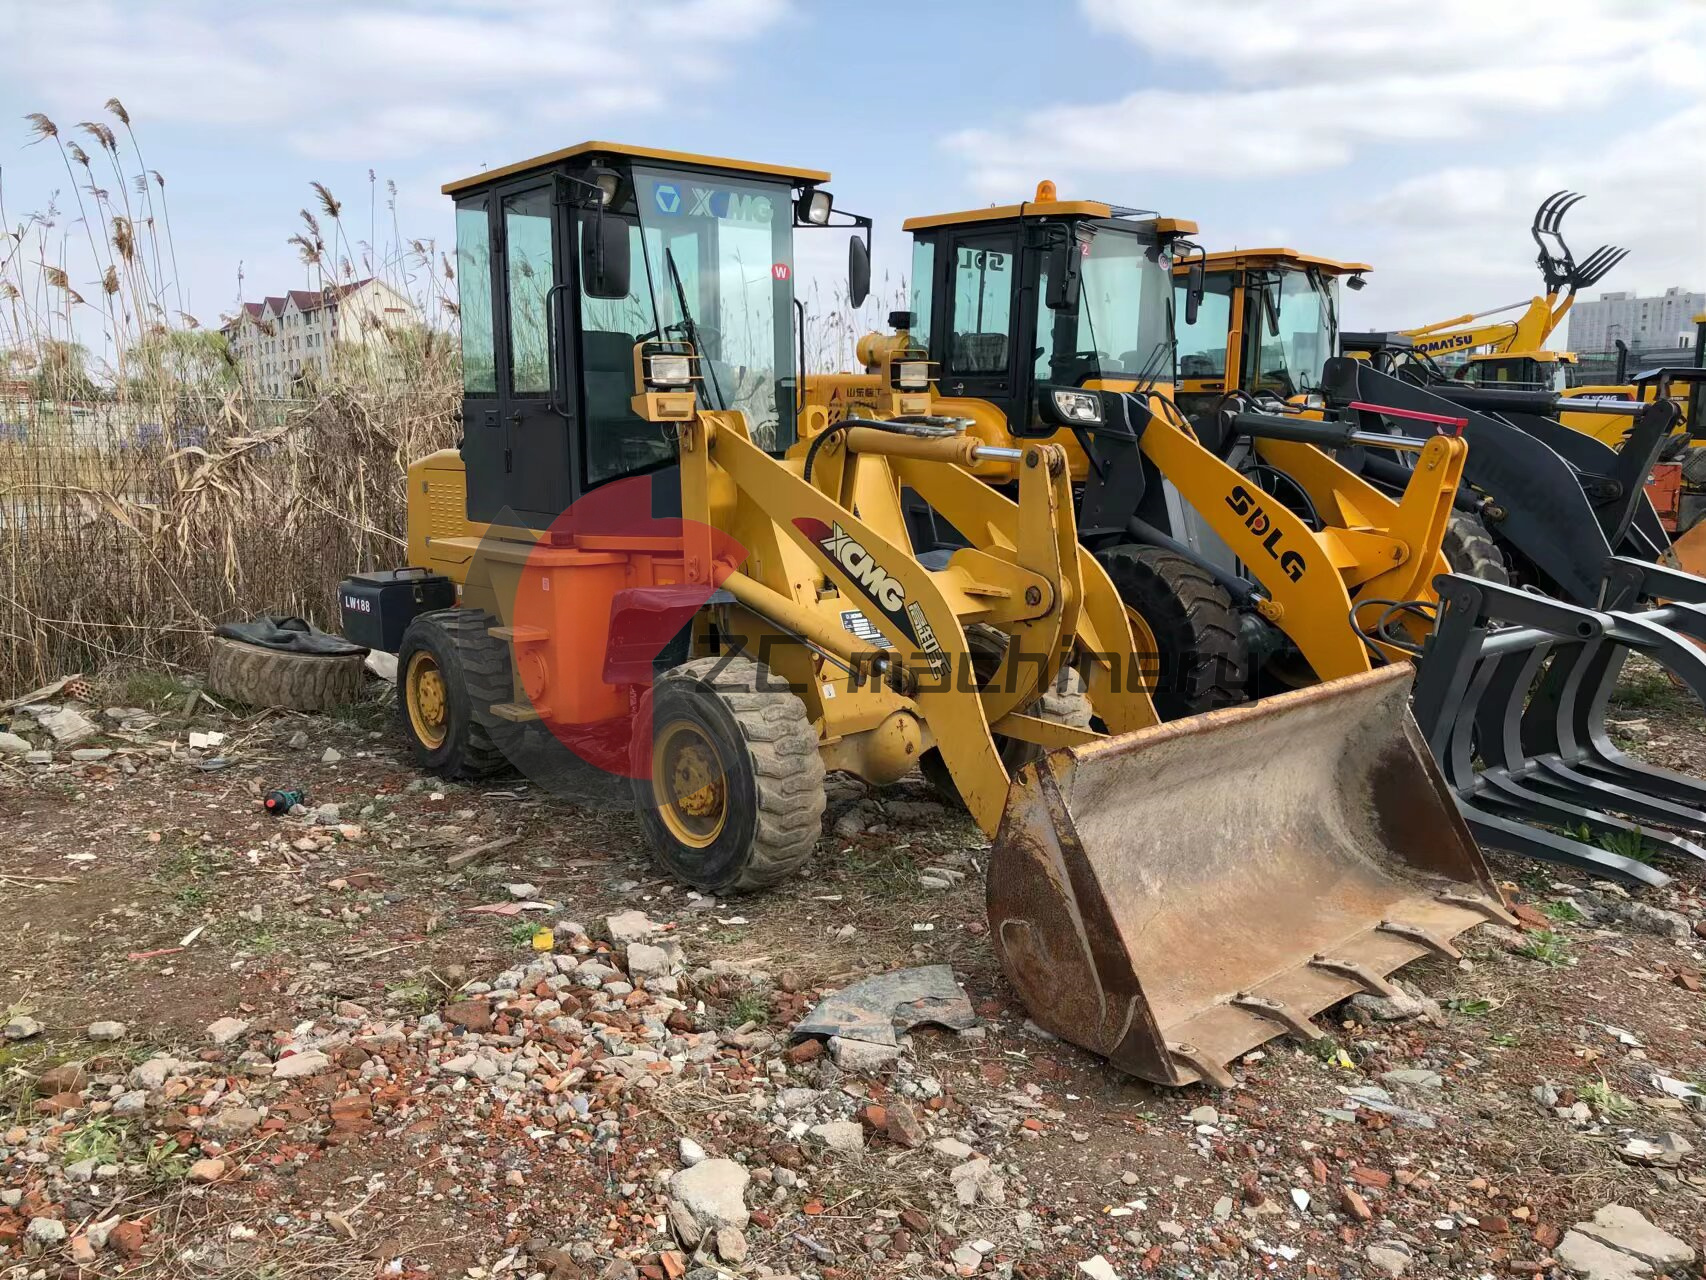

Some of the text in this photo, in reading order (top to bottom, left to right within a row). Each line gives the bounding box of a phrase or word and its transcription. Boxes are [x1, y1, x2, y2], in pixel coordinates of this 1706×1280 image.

[820, 520, 906, 612] XCMG
[1225, 485, 1306, 583] SDLG
[345, 595, 371, 613] LW188
